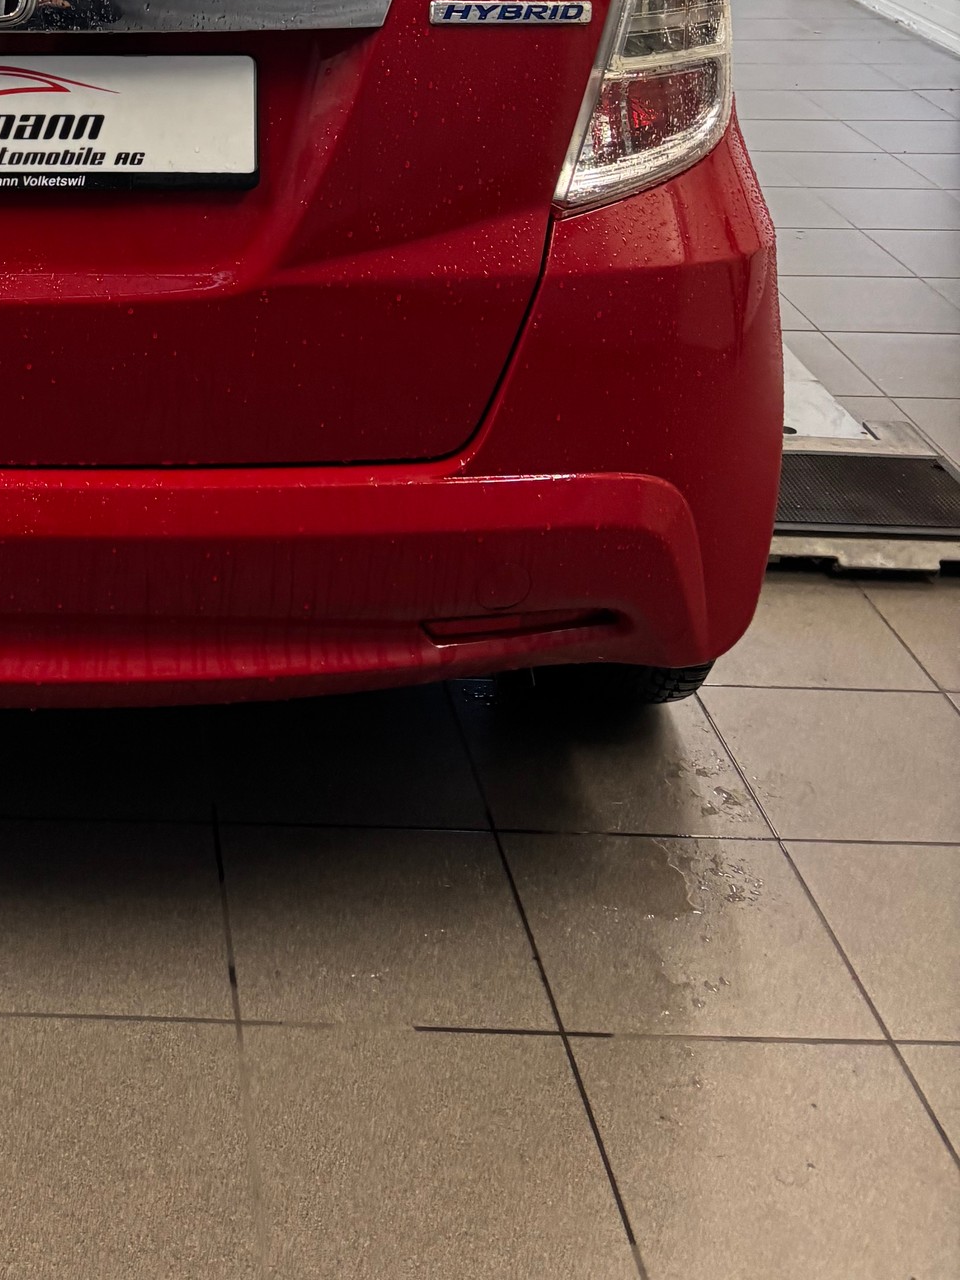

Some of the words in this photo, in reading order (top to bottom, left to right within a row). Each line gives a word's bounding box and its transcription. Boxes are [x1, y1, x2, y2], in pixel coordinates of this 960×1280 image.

[442, 4, 585, 20] HYBRID
[114, 152, 146, 166] AG
[22, 175, 86, 187] Volketswil
